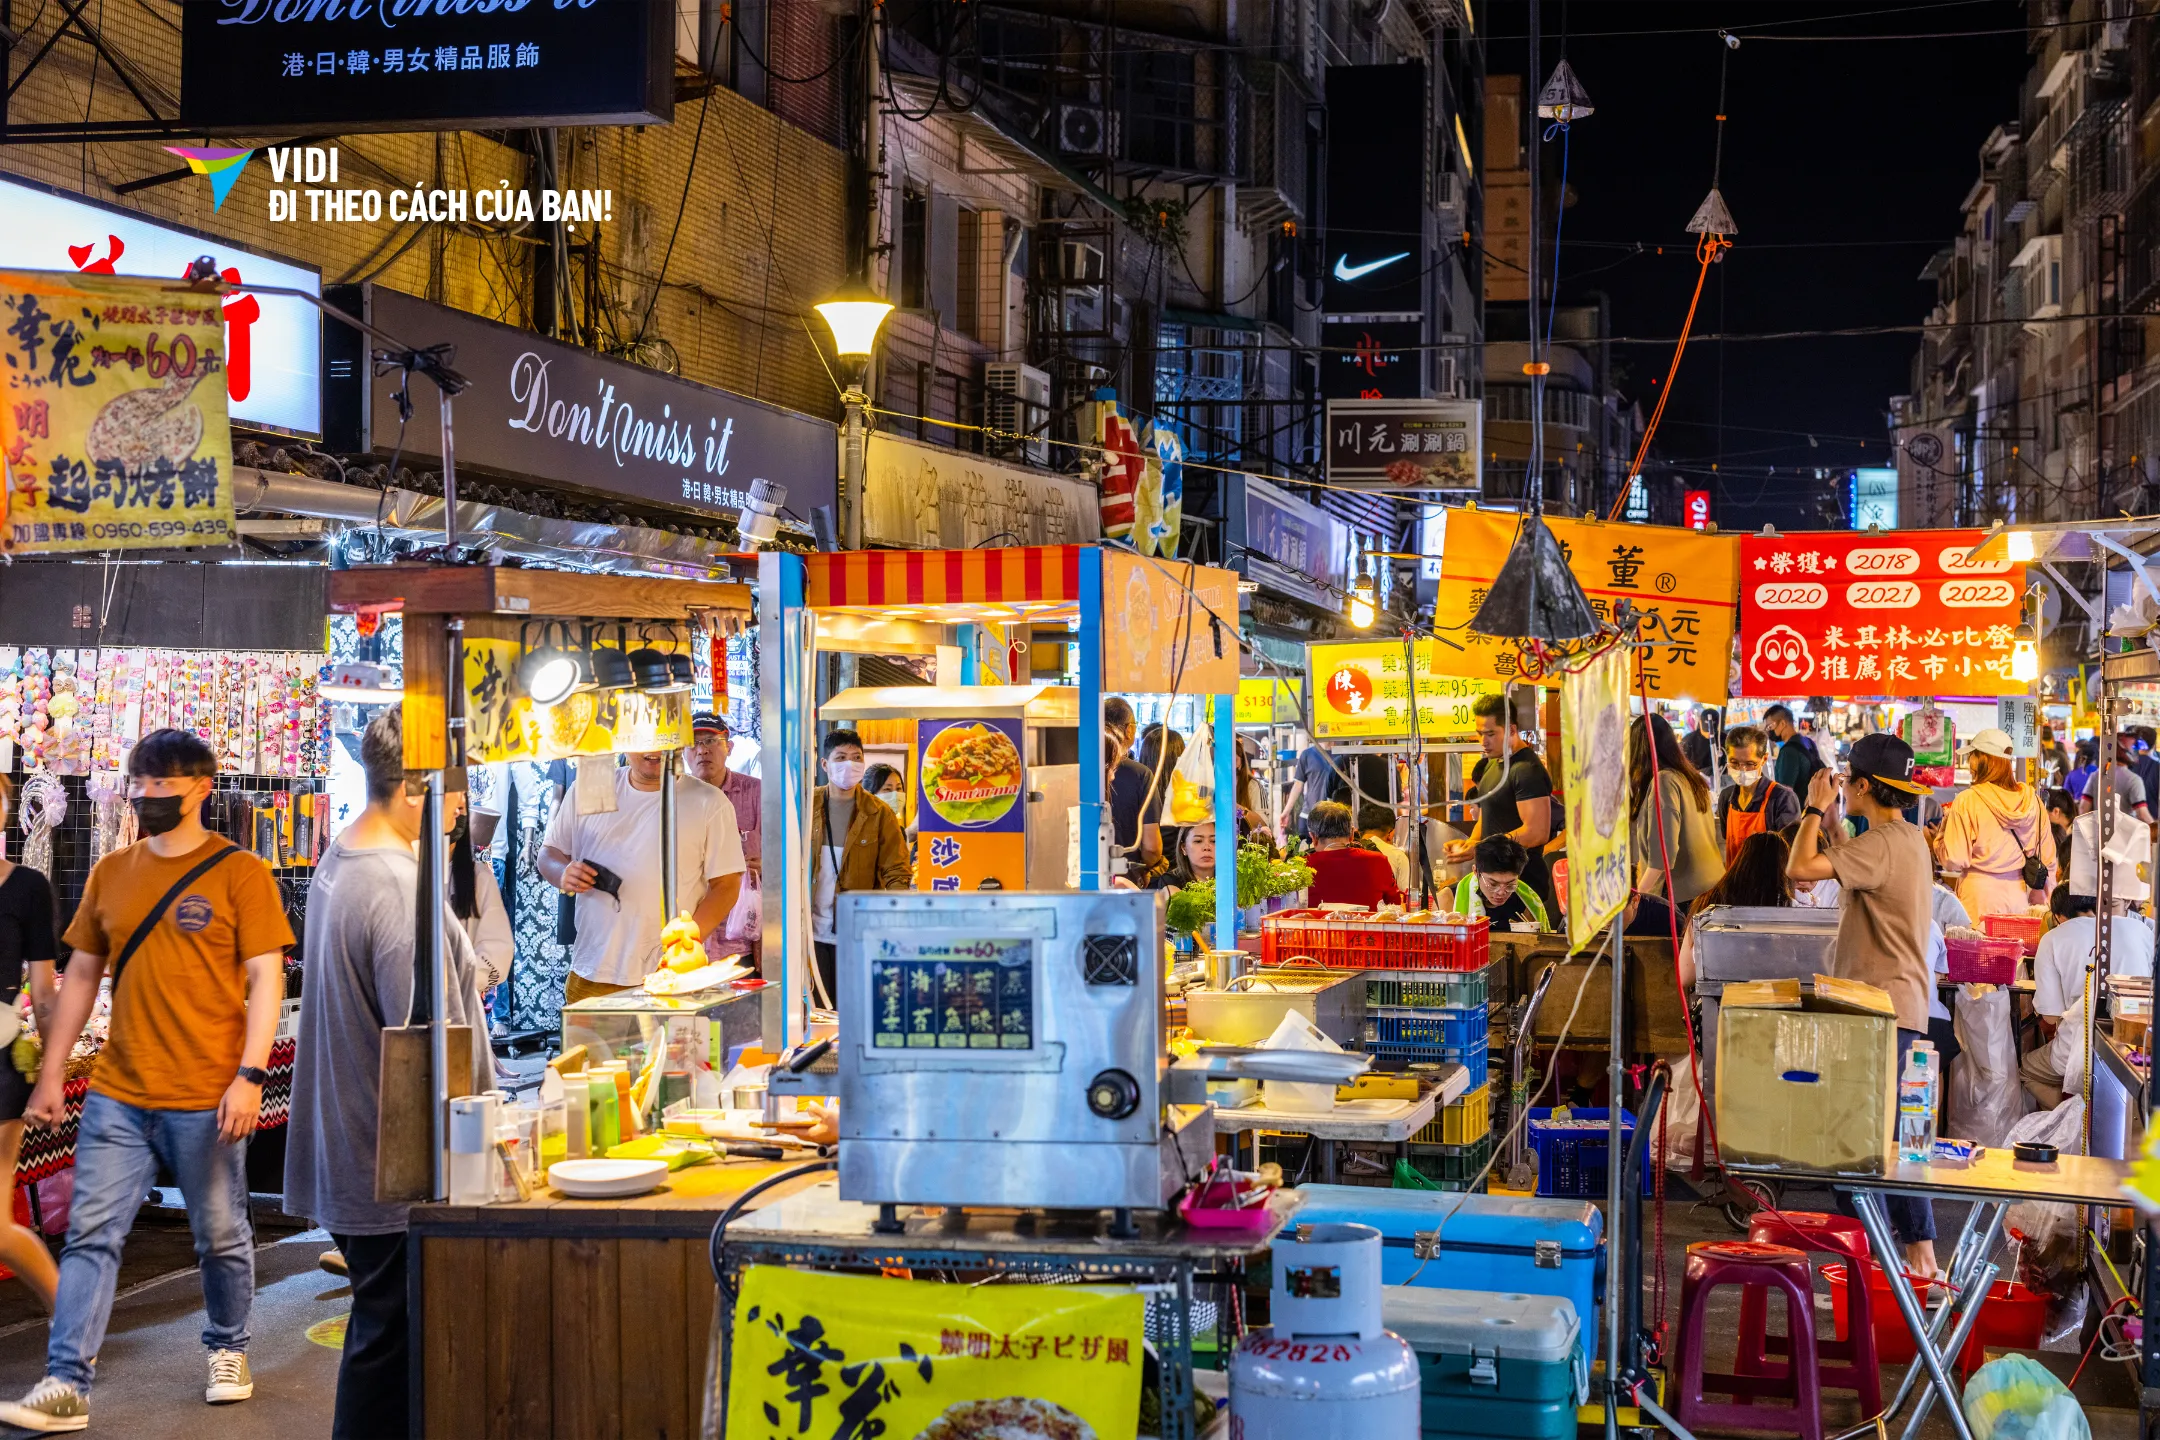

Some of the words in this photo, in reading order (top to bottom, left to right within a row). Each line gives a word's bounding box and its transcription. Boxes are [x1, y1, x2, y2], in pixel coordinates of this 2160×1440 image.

[508, 351, 615, 449] Don't
[613, 402, 697, 468] miss
[704, 417, 734, 477] it
[1338, 421, 1396, 455] 川元
[46, 454, 219, 514] 起司烤餅
[1769, 550, 1825, 575] 榮獲
[1854, 553, 1912, 571] 2018
[1761, 588, 1822, 605] 2020
[1853, 586, 1914, 604] 2021
[1945, 585, 2009, 603] 2022
[1821, 623, 2015, 651] 米其林必比登
[1820, 654, 2016, 682] 推薦夜市小吃
[932, 784, 1020, 804] Shawarma
